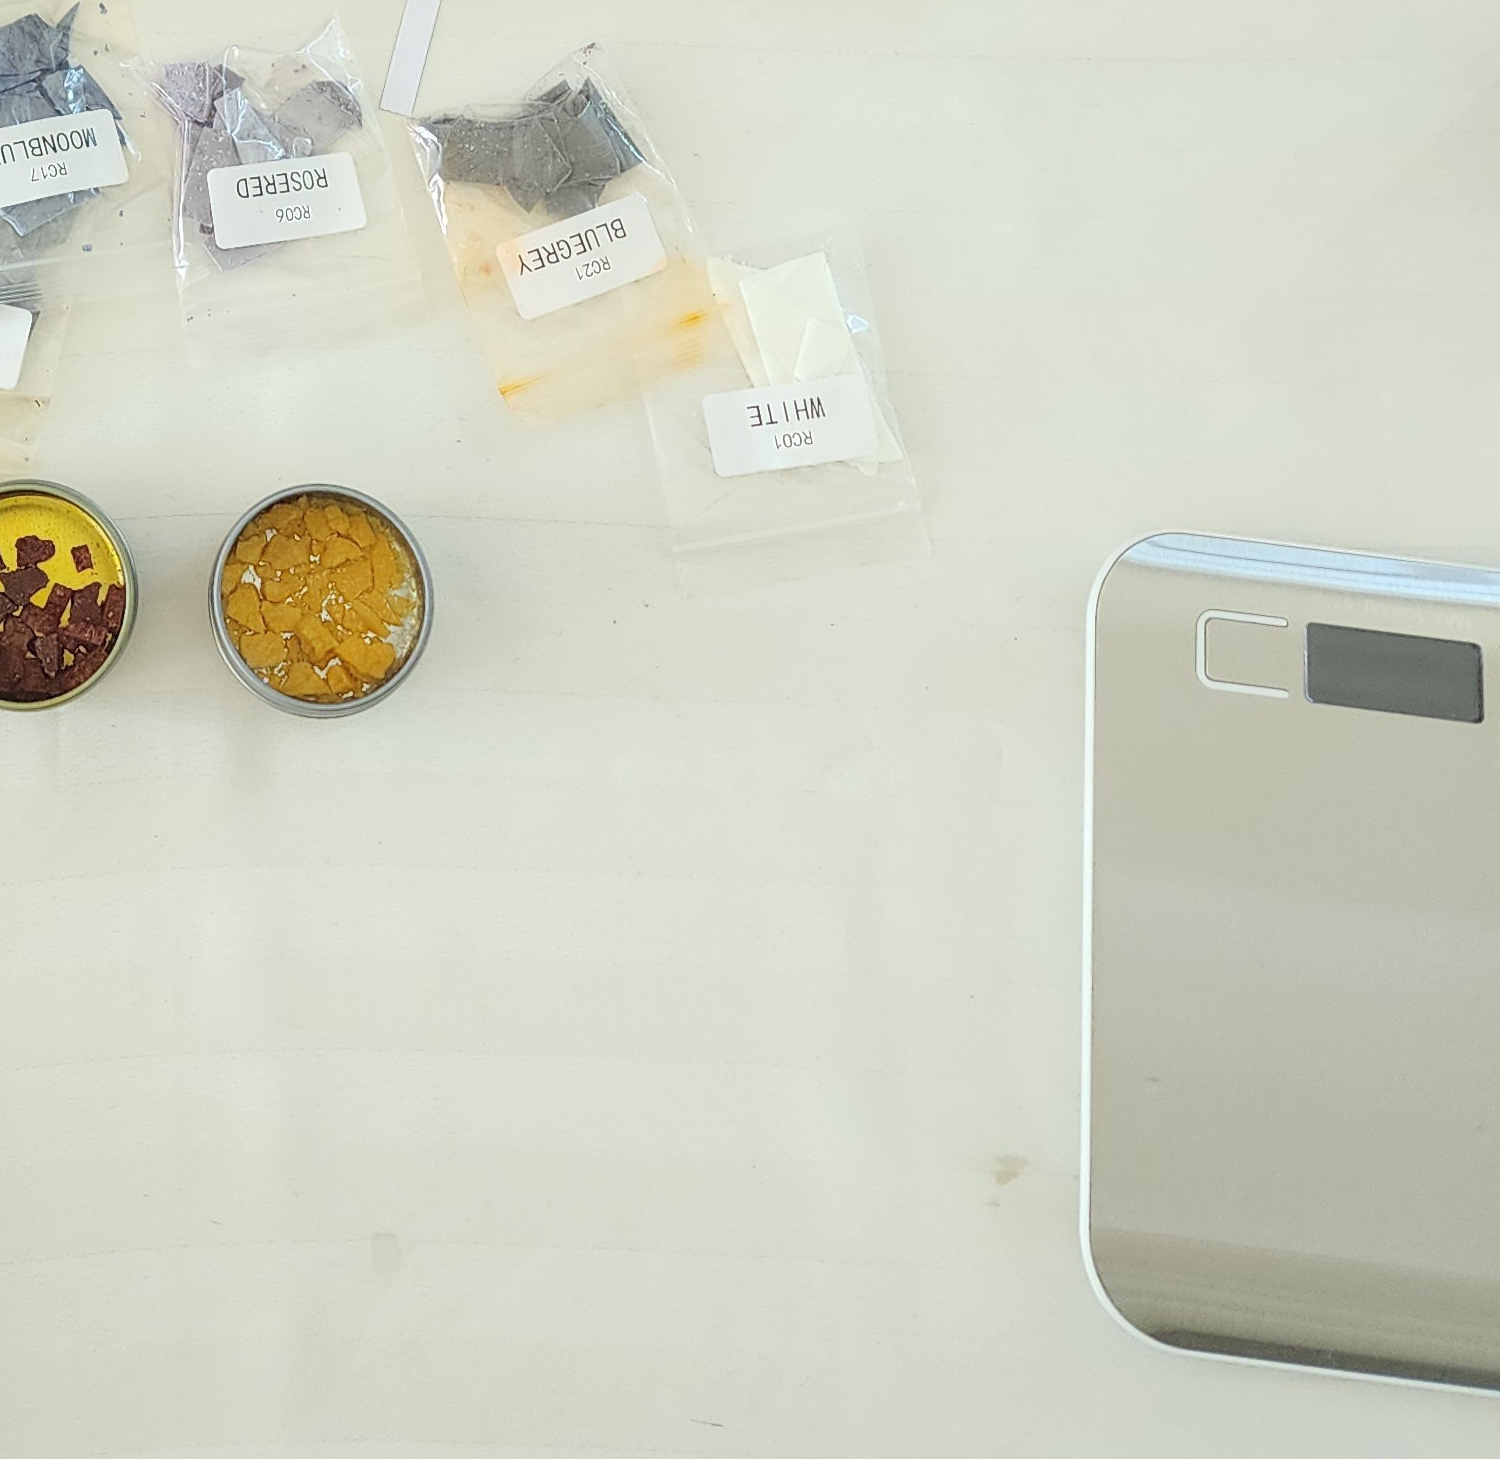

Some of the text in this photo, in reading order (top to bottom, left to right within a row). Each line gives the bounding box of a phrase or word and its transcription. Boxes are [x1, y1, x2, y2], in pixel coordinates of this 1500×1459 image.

[29, 163, 68, 183] RC17
[236, 167, 329, 199] ROSERED
[275, 205, 311, 223] RC06
[517, 216, 627, 276] BLUEGREY
[574, 255, 611, 280] RC21
[746, 397, 826, 428] WHITE
[773, 431, 814, 450] RC01
